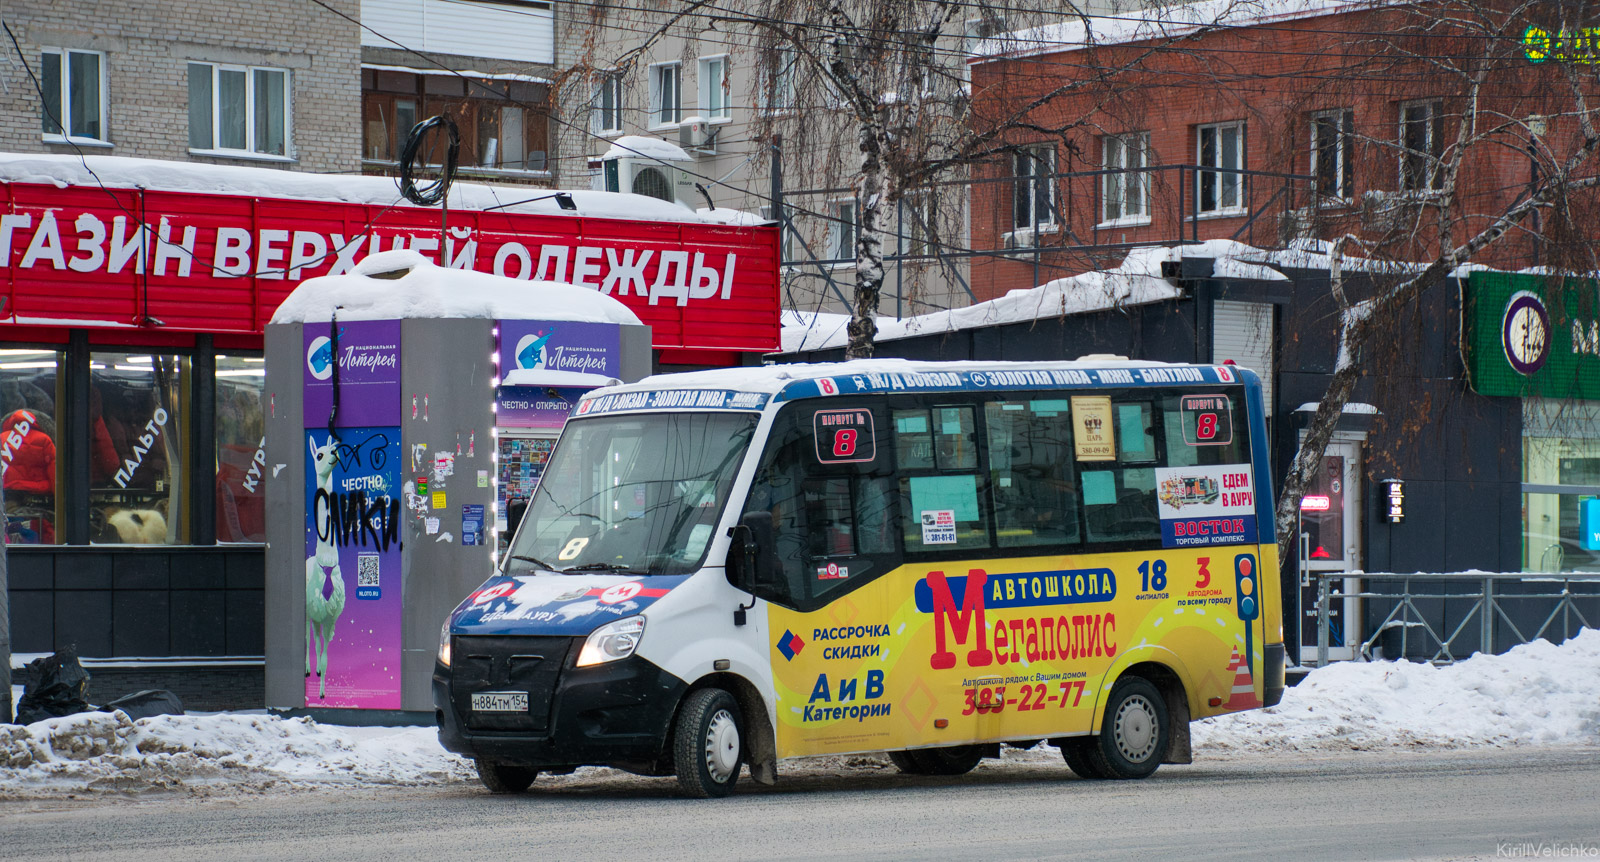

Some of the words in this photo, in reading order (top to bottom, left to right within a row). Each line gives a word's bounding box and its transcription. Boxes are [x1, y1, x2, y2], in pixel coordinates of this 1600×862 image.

[339, 345, 396, 373] Лотерея
[548, 345, 607, 374] Лотерея
[818, 378, 834, 394] 8
[902, 372, 962, 388] ВОКЗАЛ
[985, 371, 1053, 386] ЗОЛОТАЯ
[1050, 370, 1092, 385] НИВА
[1096, 368, 1135, 384] МЖК
[1139, 367, 1204, 383] БИАТЛОН
[1217, 367, 1231, 382] 8
[501, 400, 529, 410] ЧЕСТНО
[535, 401, 568, 411] ОТКРЫТО
[580, 399, 592, 413] 8
[651, 390, 699, 407] ЗОЛОТАЯ
[695, 391, 726, 407] НИВА
[1187, 399, 1215, 410] МАРШРУТ
[821, 413, 854, 426] МАРШРУТ
[1197, 413, 1218, 439] 8
[113, 407, 168, 489] ПАЛЬТО
[833, 429, 858, 456] 8
[1222, 473, 1248, 490] ЕДЕМ
[1222, 493, 1229, 507] В
[1231, 492, 1252, 507] АУРУ
[1174, 519, 1245, 536] ВОСТОК
[558, 537, 589, 560] 8
[1176, 537, 1209, 546] ТОРГОВЫЙ
[1211, 535, 1245, 544] КОМПЛЕКС
[1137, 559, 1167, 592] 18
[1195, 557, 1211, 589] 3
[992, 573, 1113, 601] АВТОШКОЛА
[1187, 589, 1222, 597] АВТОДРОМА
[358, 590, 379, 602] NLOTO.RU
[1135, 592, 1169, 601] ФИЛИАЛОВ
[1177, 599, 1186, 607] по
[1188, 597, 1207, 606] всему
[1208, 596, 1232, 606] городу
[522, 611, 559, 621] АУРУ
[926, 568, 1117, 670] Мегаполис
[813, 624, 891, 641] РАССРОЧКА
[823, 644, 880, 660] СКИДКИ
[808, 673, 831, 704] А
[838, 678, 857, 701] и
[865, 669, 884, 699] В
[962, 678, 1004, 687] Автошкола
[1005, 675, 1029, 685] рядом
[1036, 673, 1061, 682] Вашим
[1062, 671, 1087, 681] домом
[475, 696, 510, 709] Н884ТМ
[511, 695, 527, 706] 154
[803, 703, 891, 722] Категории
